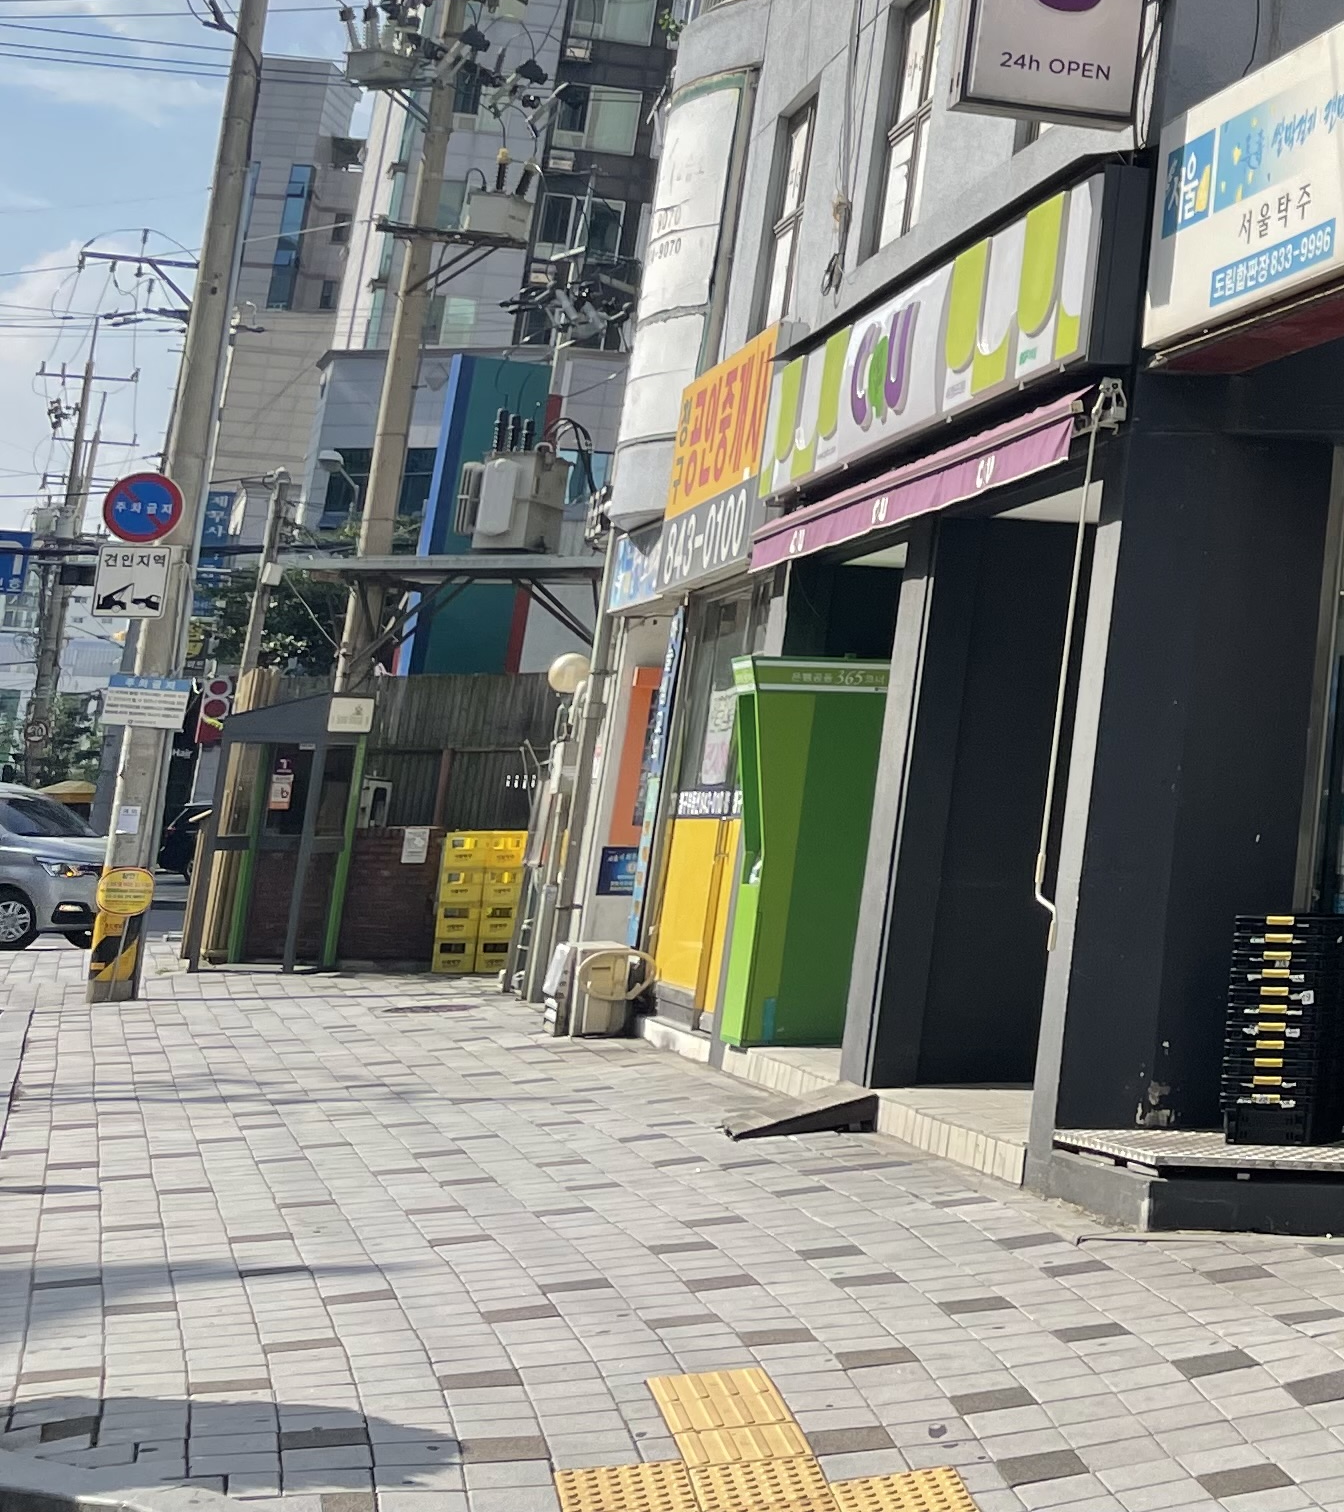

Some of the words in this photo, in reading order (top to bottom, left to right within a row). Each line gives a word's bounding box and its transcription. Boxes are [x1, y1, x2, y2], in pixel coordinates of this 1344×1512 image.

[1000, 50, 1041, 73] 24h
[1048, 57, 1112, 82] OPEN
[1238, 183, 1312, 244] 서울탁주
[976, 454, 996, 489] CU
[663, 488, 747, 585] 843-0100
[104, 553, 167, 568] 견인지역
[834, 670, 865, 685] 365
